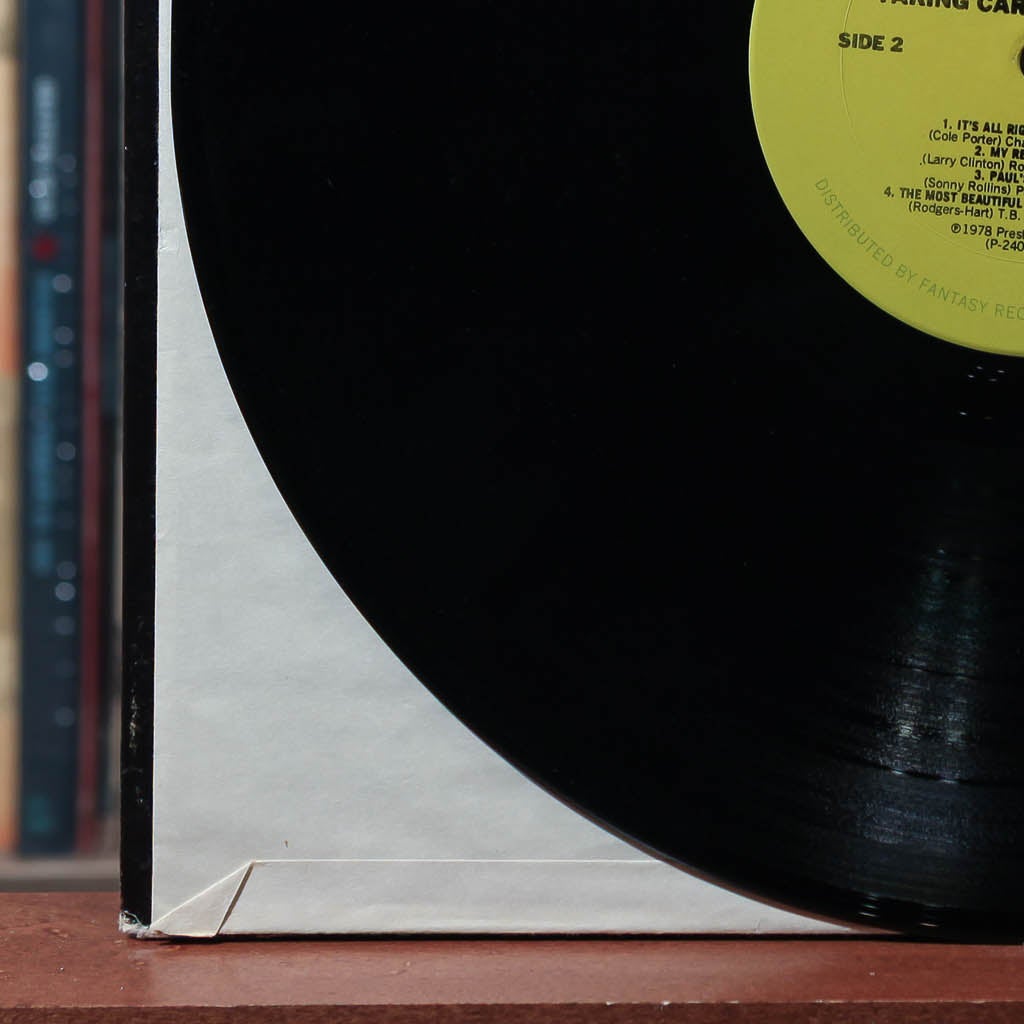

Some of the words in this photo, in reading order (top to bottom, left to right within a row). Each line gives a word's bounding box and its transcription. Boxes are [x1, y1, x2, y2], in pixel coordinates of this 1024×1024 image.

[838, 32, 886, 51] SIDE
[890, 36, 904, 53] 2
[943, 118, 953, 130] 1.
[957, 119, 980, 132] IT'S
[982, 122, 1004, 134] ALL
[928, 129, 959, 143] (Cole
[962, 131, 1002, 147] Porter)
[974, 145, 986, 157] 2.
[989, 146, 1009, 159] MY
[922, 153, 957, 169] (Larry
[959, 156, 1005, 173] Clinton)
[973, 169, 985, 182] 3.
[924, 176, 965, 193] (Sonny
[967, 180, 1012, 196] Rollins)
[883, 186, 895, 198] 4.
[899, 187, 923, 200] THE
[924, 189, 959, 203] MOST
[960, 192, 1023, 209] BEAUTIFUL
[908, 201, 994, 220] (Rodgers-Hart)
[998, 208, 1021, 222] T.B.
[815, 178, 894, 267] DISTRIBUTED
[895, 264, 918, 284] BY
[919, 277, 988, 313] FANTASY
